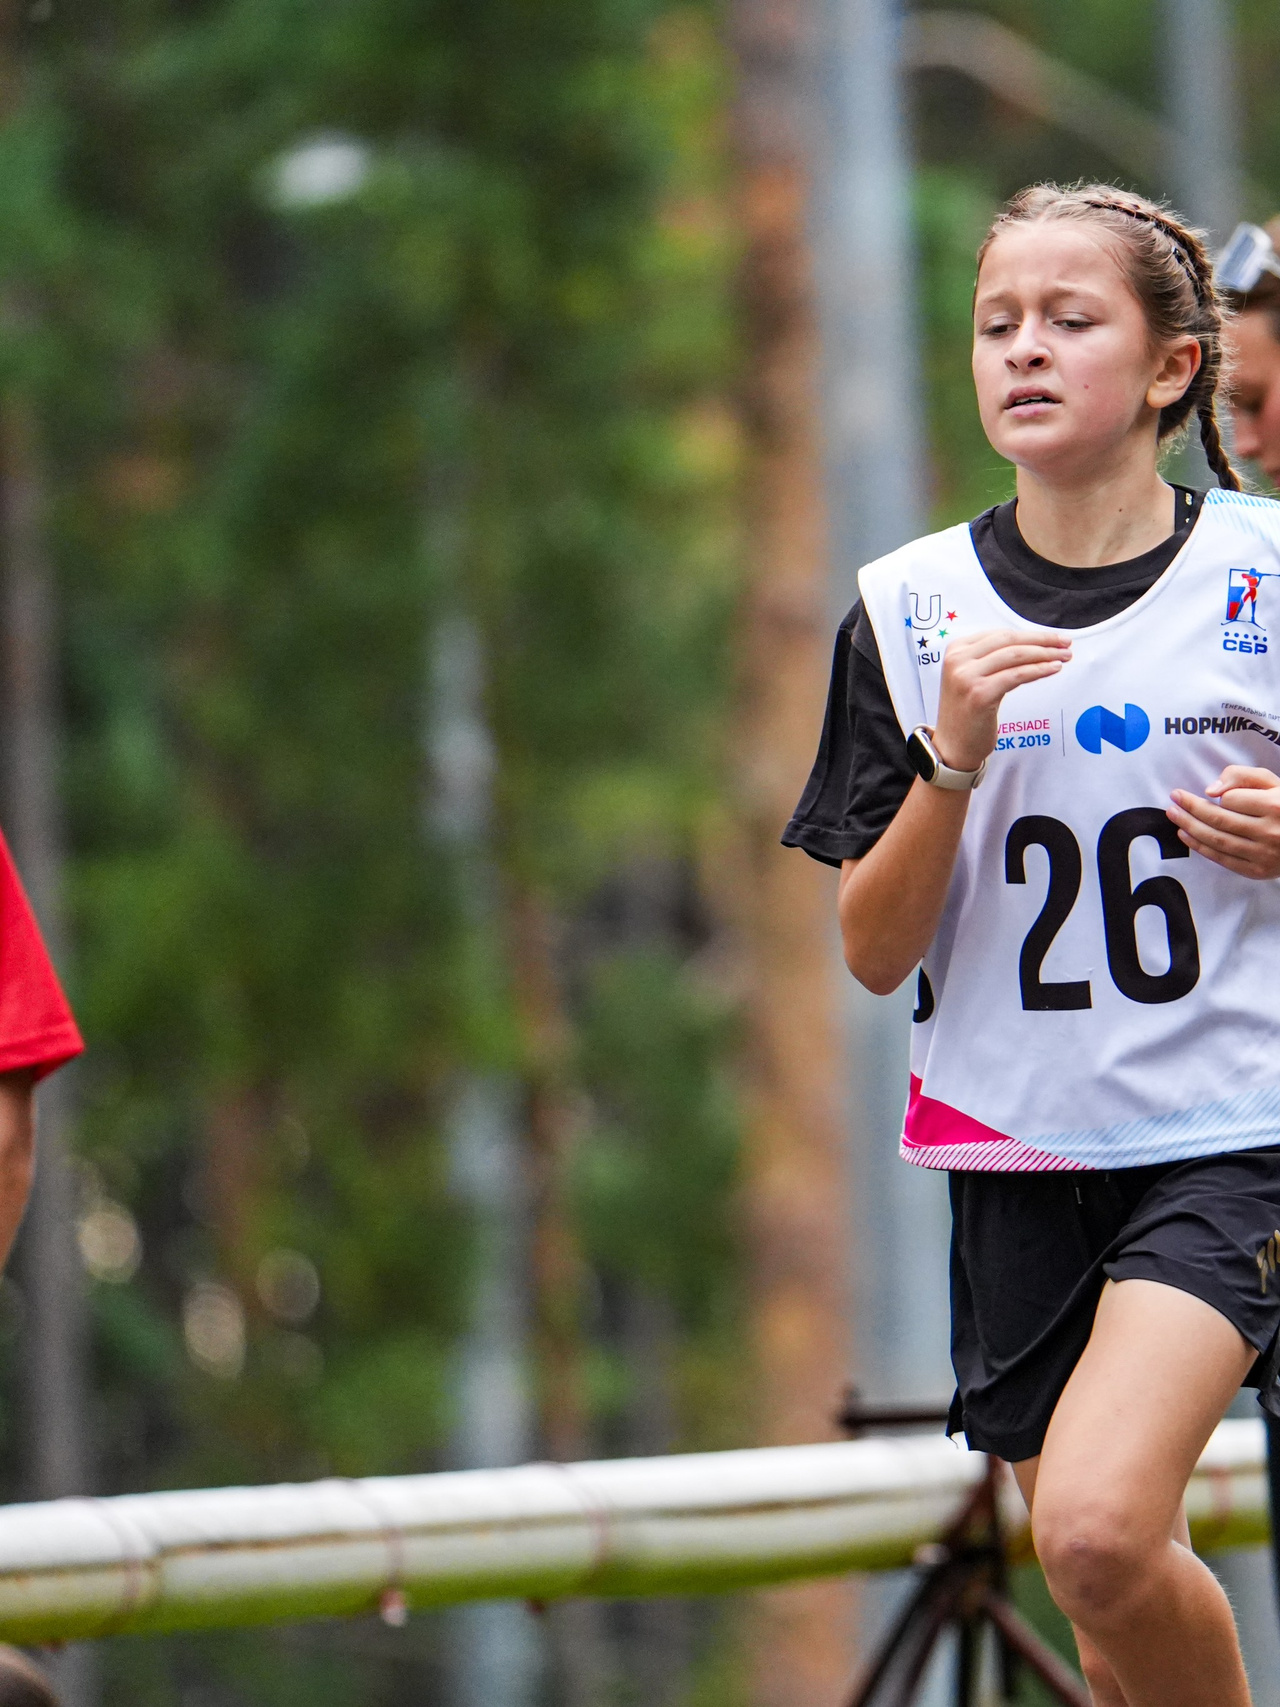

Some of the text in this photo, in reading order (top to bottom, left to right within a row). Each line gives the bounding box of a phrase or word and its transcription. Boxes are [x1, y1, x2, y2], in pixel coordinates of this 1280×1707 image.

[1222, 638, 1268, 655] СБР
[916, 651, 941, 666] ISU
[1221, 702, 1267, 718] ГЕНЕРАЛЬНЫЙ
[994, 734, 1051, 751] SK 2019
[1004, 806, 1201, 1012] 26
